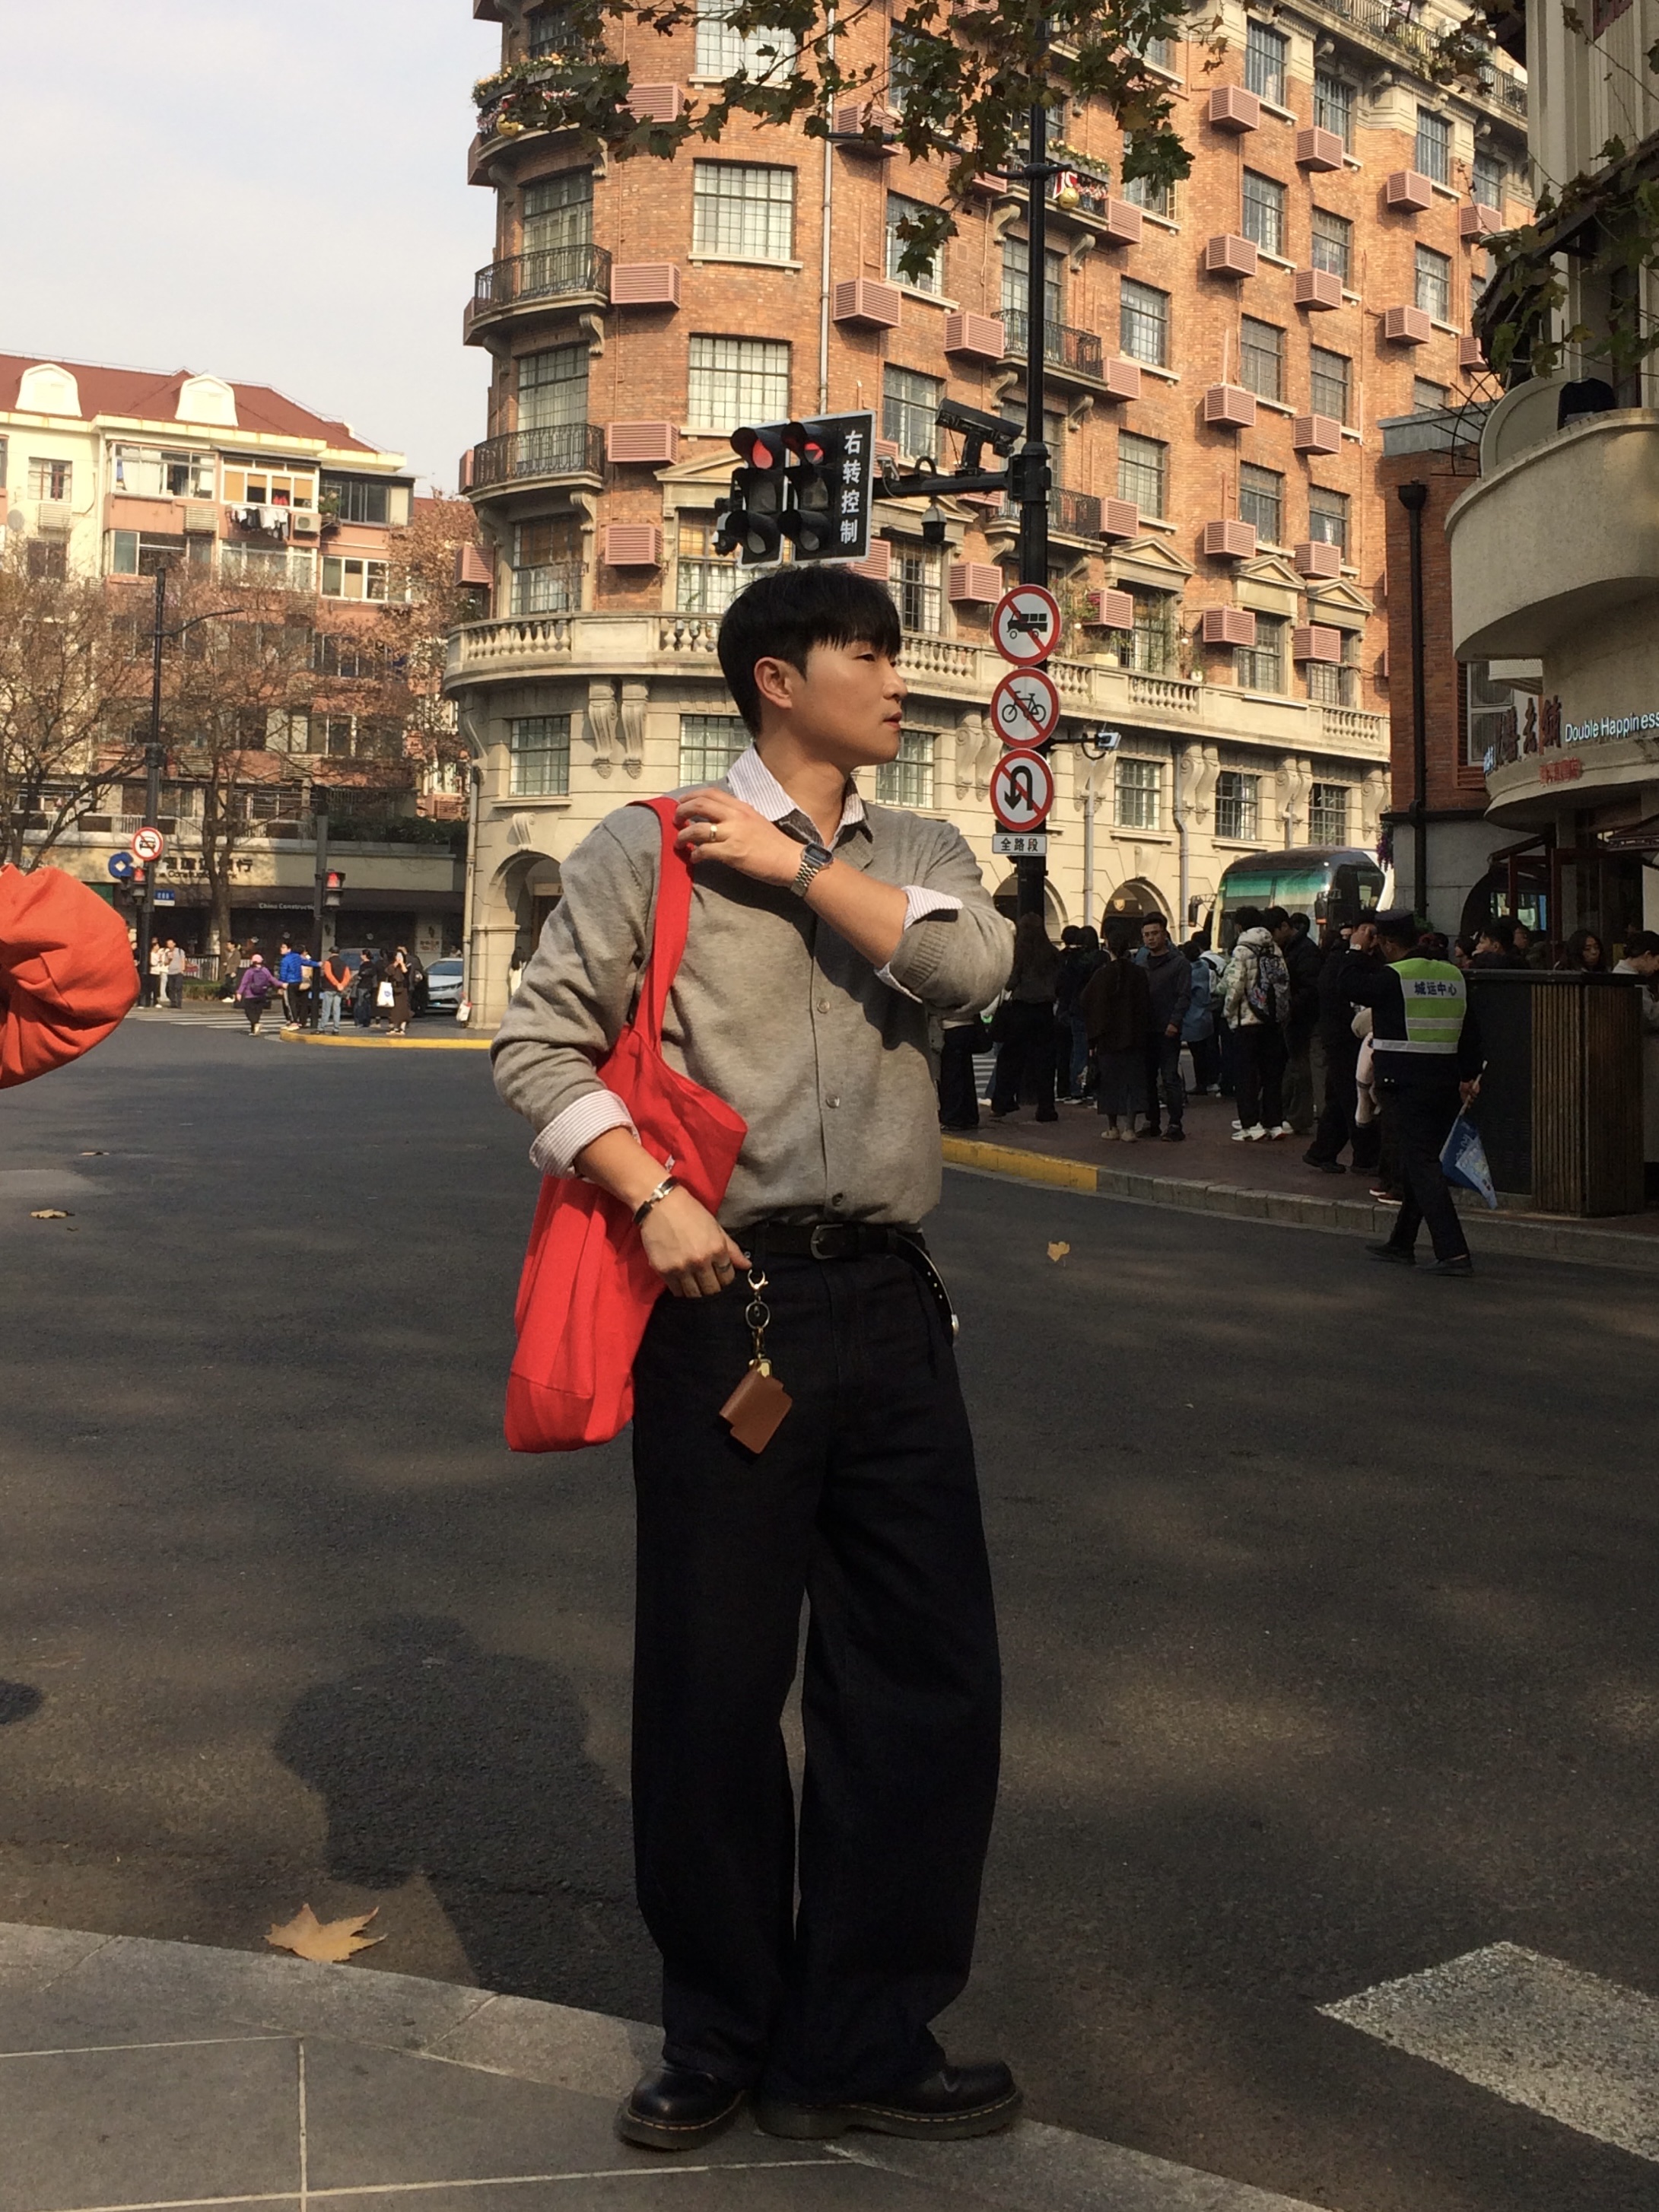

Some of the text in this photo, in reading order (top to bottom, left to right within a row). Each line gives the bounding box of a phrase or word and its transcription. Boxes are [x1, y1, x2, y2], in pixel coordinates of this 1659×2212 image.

[841, 430, 863, 544] 右转控制
[1565, 720, 1599, 742] Double
[1000, 837, 1038, 852] 全路段
[1414, 981, 1457, 996] 城运中心
